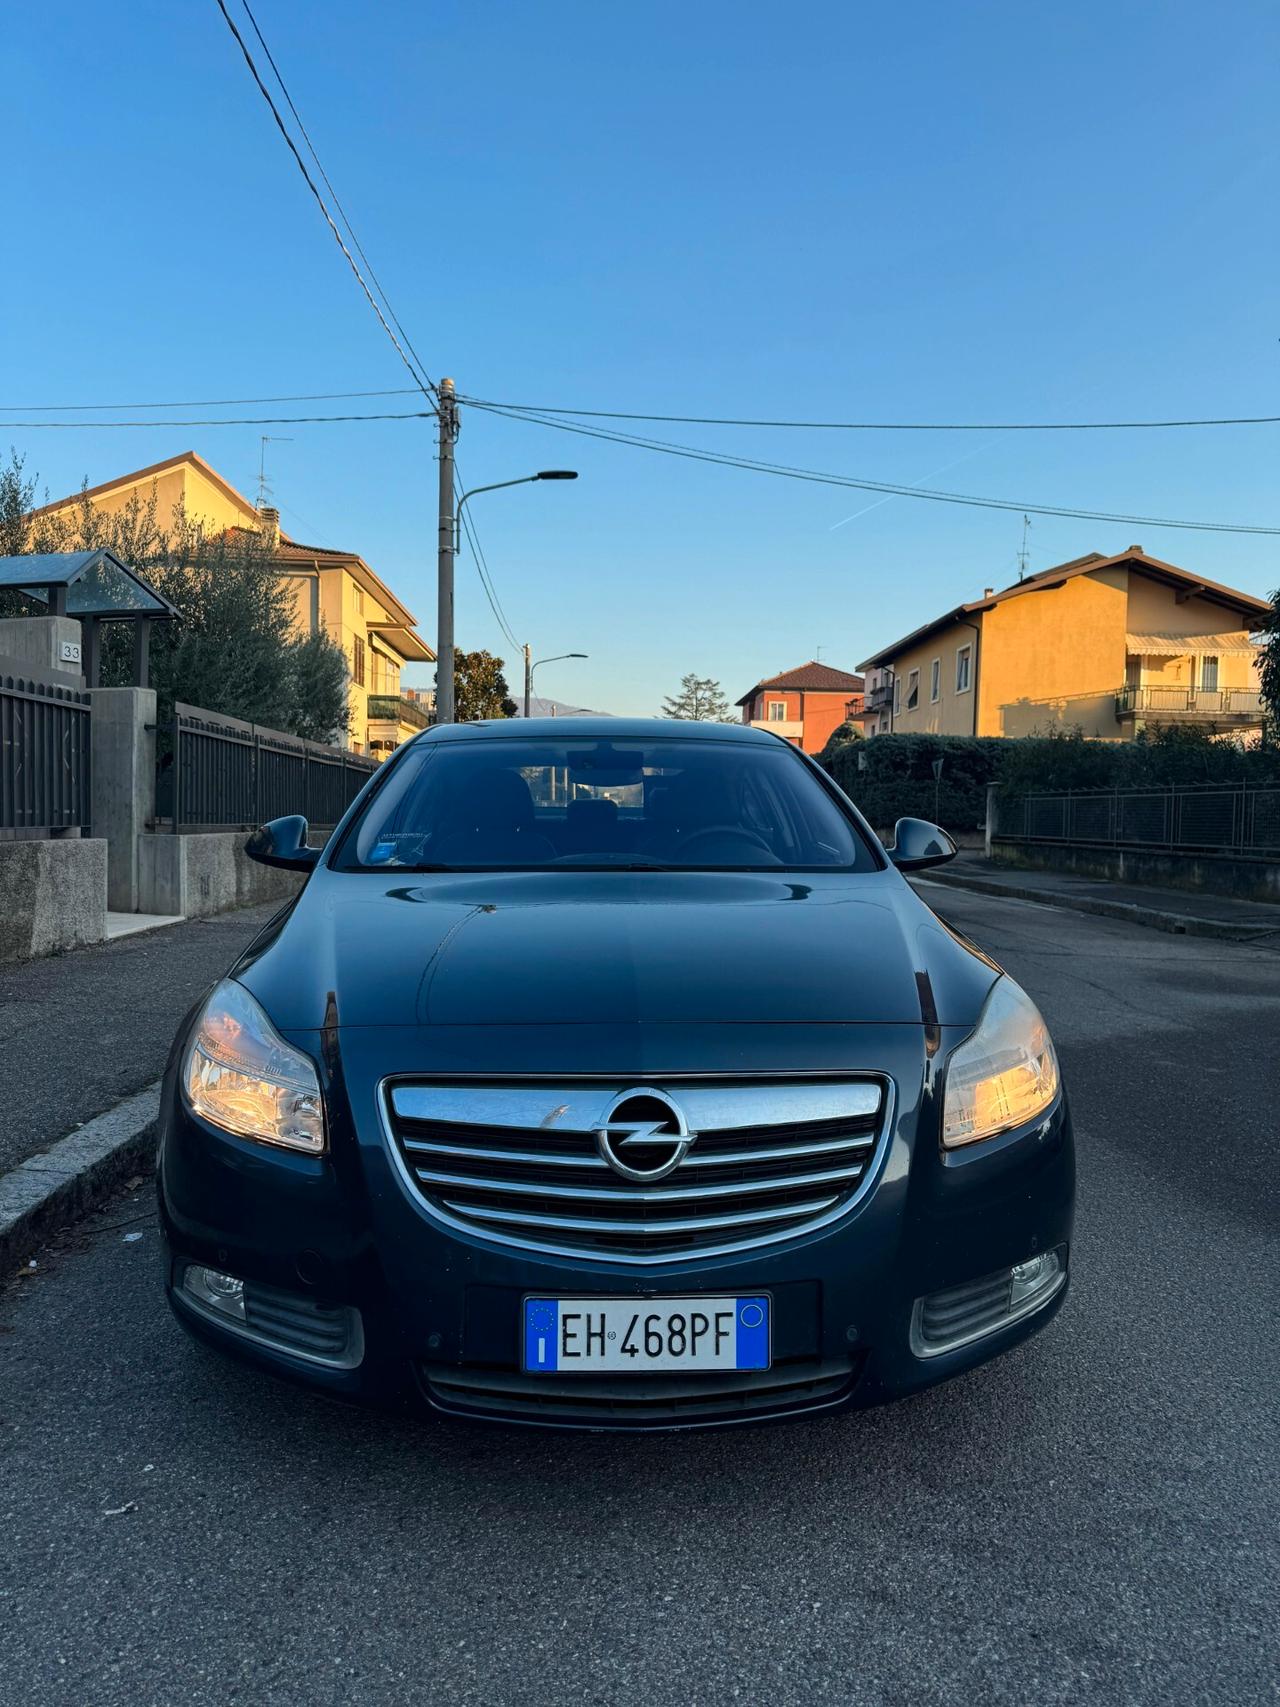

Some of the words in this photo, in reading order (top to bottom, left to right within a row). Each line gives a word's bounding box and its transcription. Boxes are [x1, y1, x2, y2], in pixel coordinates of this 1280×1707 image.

[64, 646, 80, 659] 33
[562, 1313, 606, 1357] EH
[620, 1312, 734, 1358] 468PF
